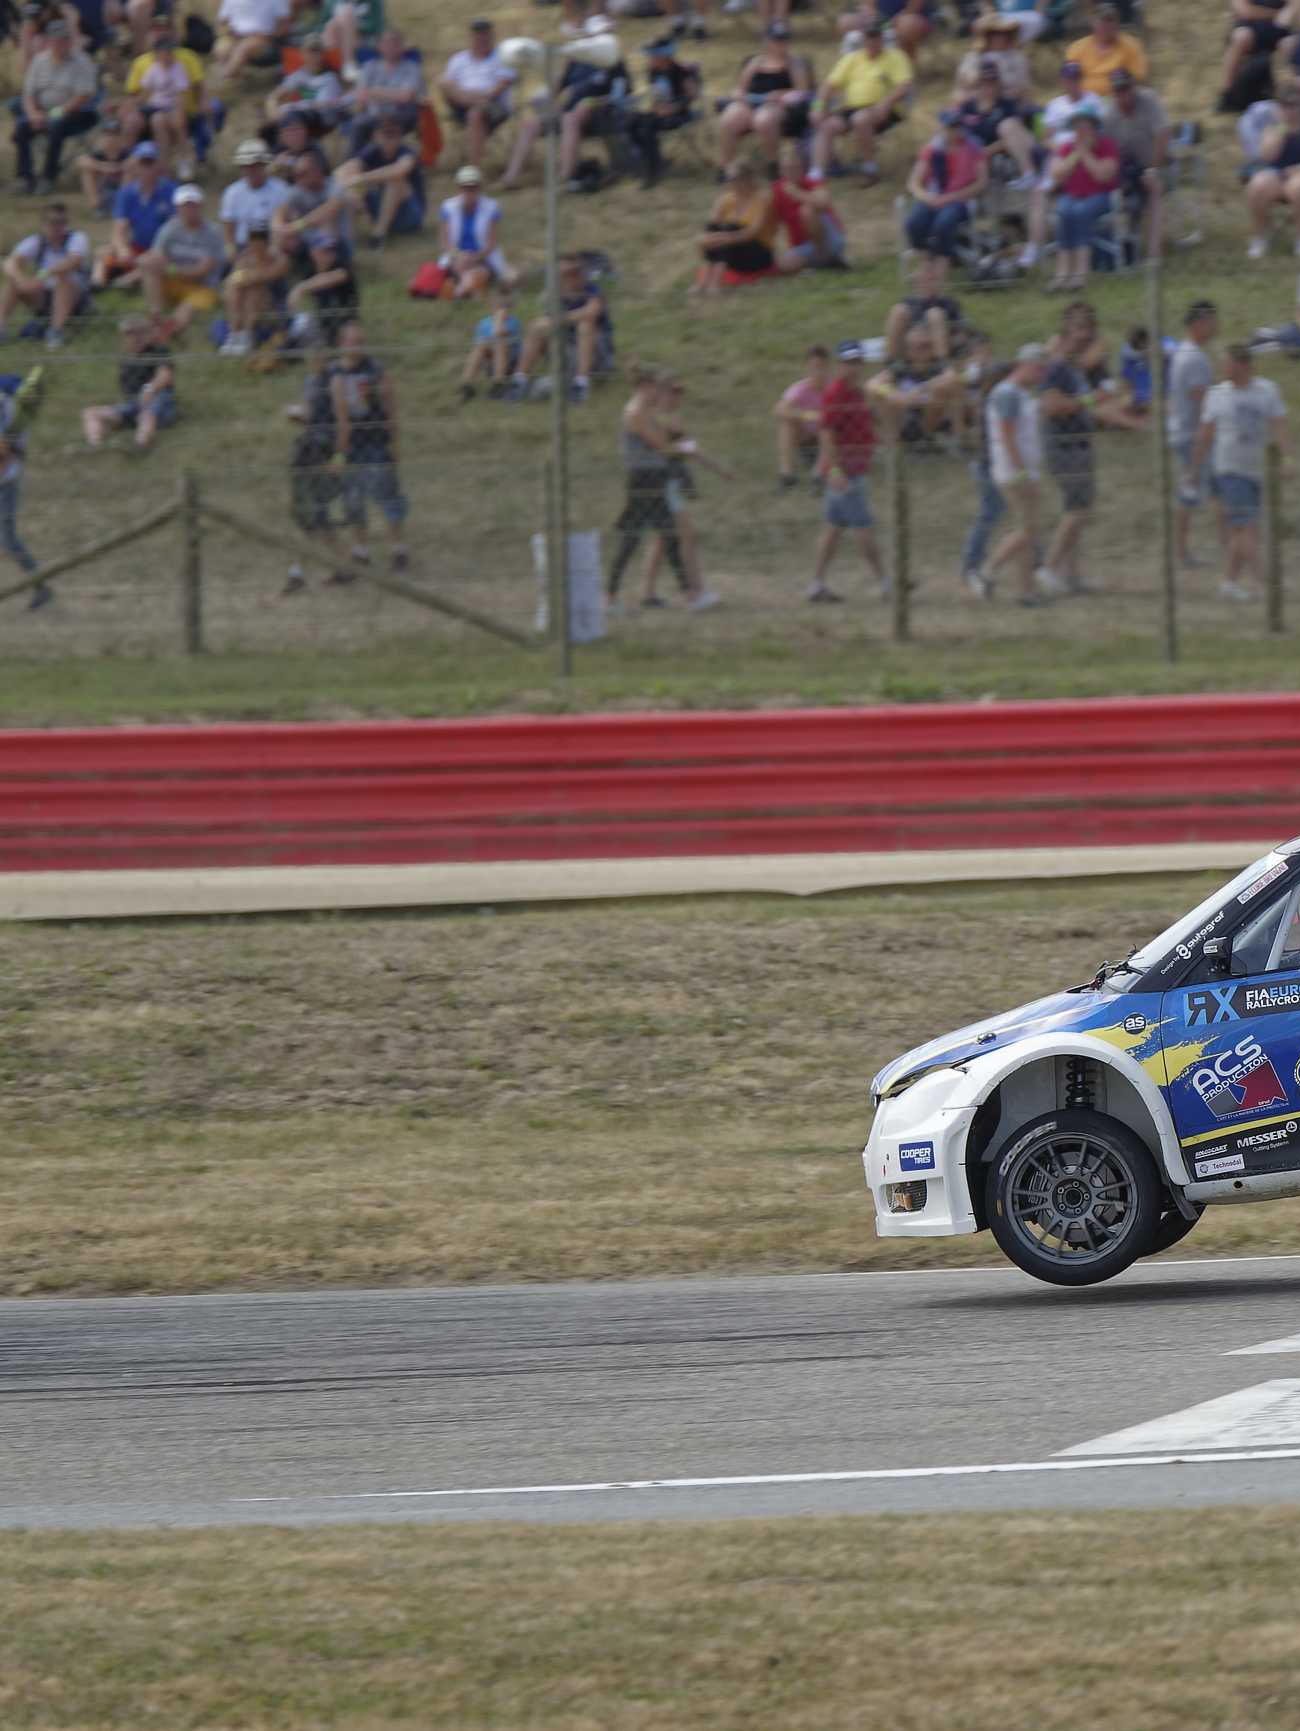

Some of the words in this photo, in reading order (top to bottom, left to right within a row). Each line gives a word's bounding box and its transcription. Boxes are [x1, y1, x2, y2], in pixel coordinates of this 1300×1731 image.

[1187, 910, 1225, 949] autograf
[1125, 1016, 1145, 1030] as
[1193, 1034, 1262, 1096] ACS
[1202, 1053, 1269, 1102] PRODUCTION
[1237, 1129, 1288, 1149] MESSER
[901, 1147, 931, 1159] COOPER
[914, 1156, 931, 1165] TIRES
